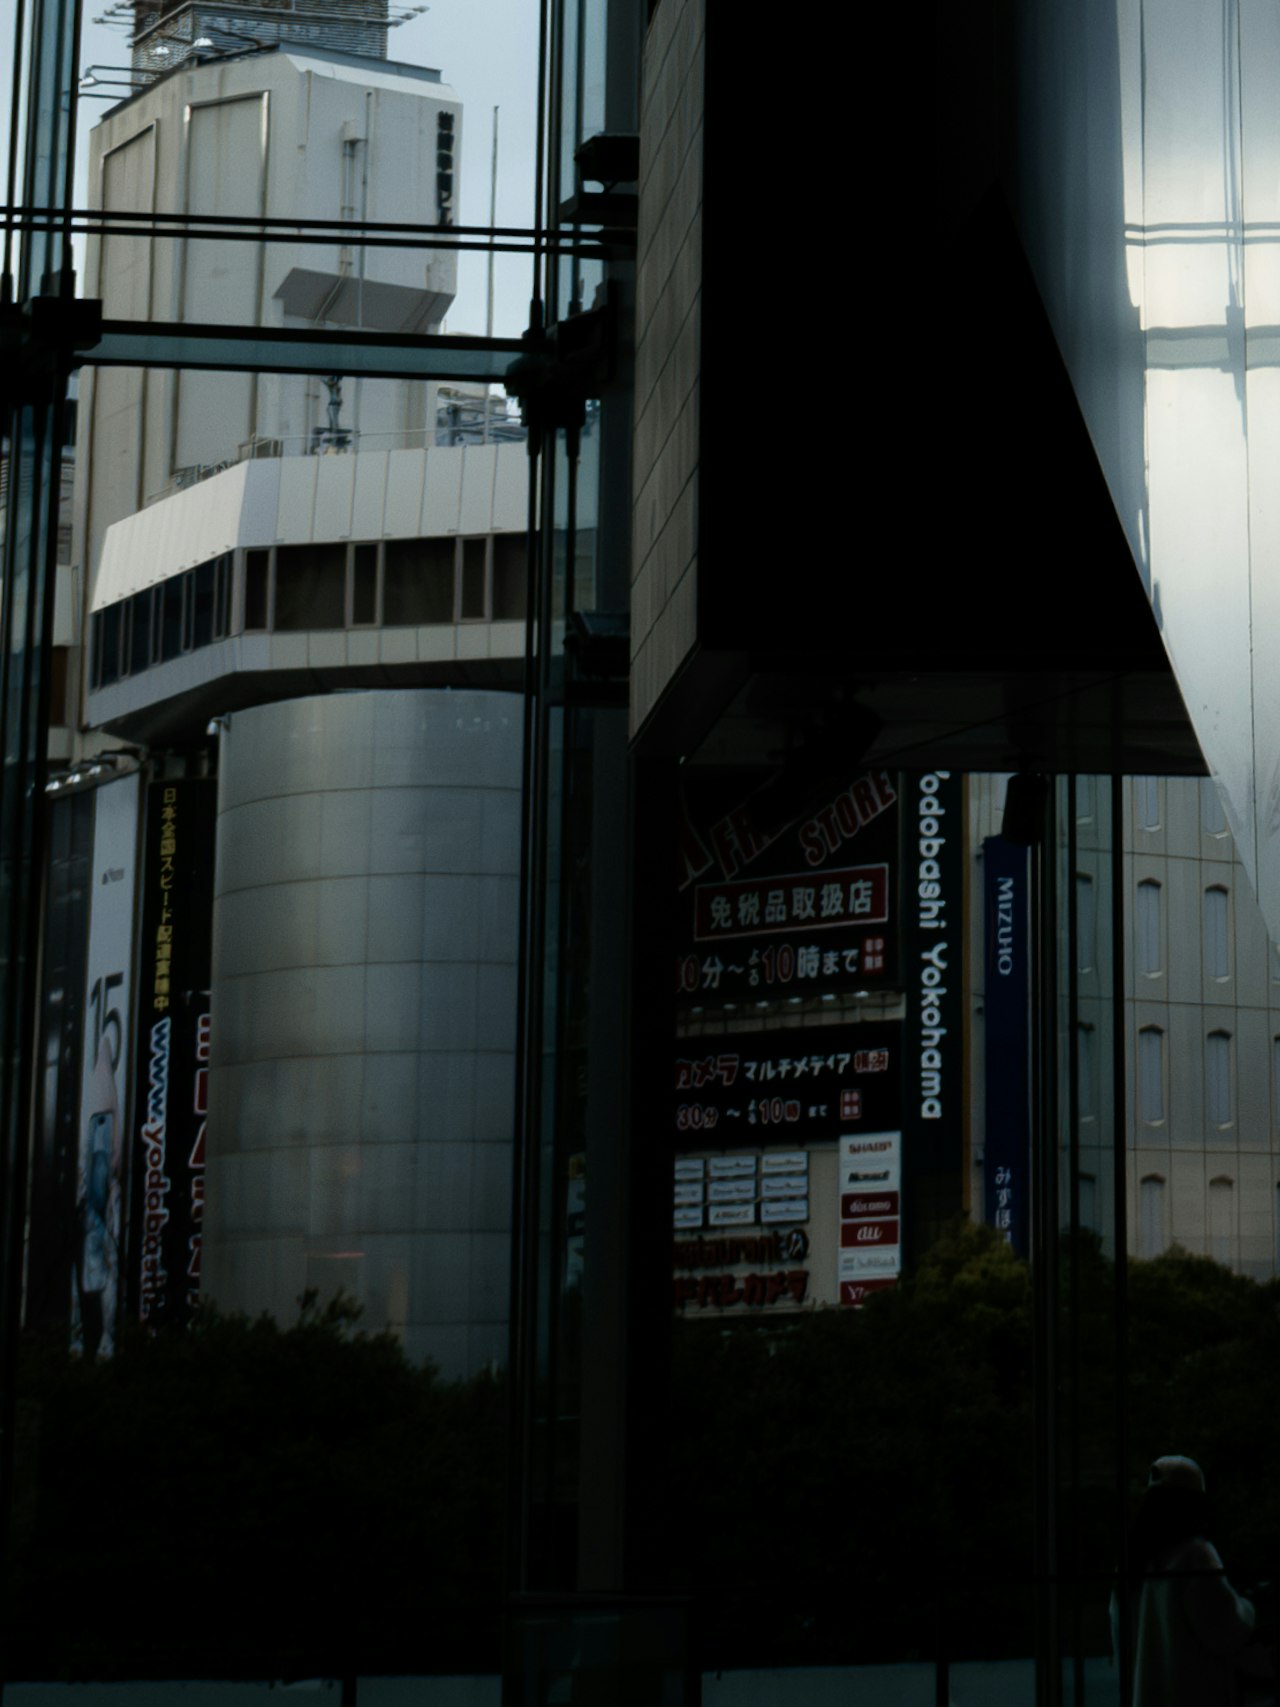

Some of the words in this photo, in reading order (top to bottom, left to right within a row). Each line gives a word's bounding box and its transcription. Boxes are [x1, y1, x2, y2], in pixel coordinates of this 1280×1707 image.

[799, 770, 897, 866] STORE
[709, 879, 873, 929] 免税品取扱店
[998, 877, 1014, 976] MIZUHO
[920, 942, 948, 1119] Yokohama
[857, 1225, 883, 1241] au
